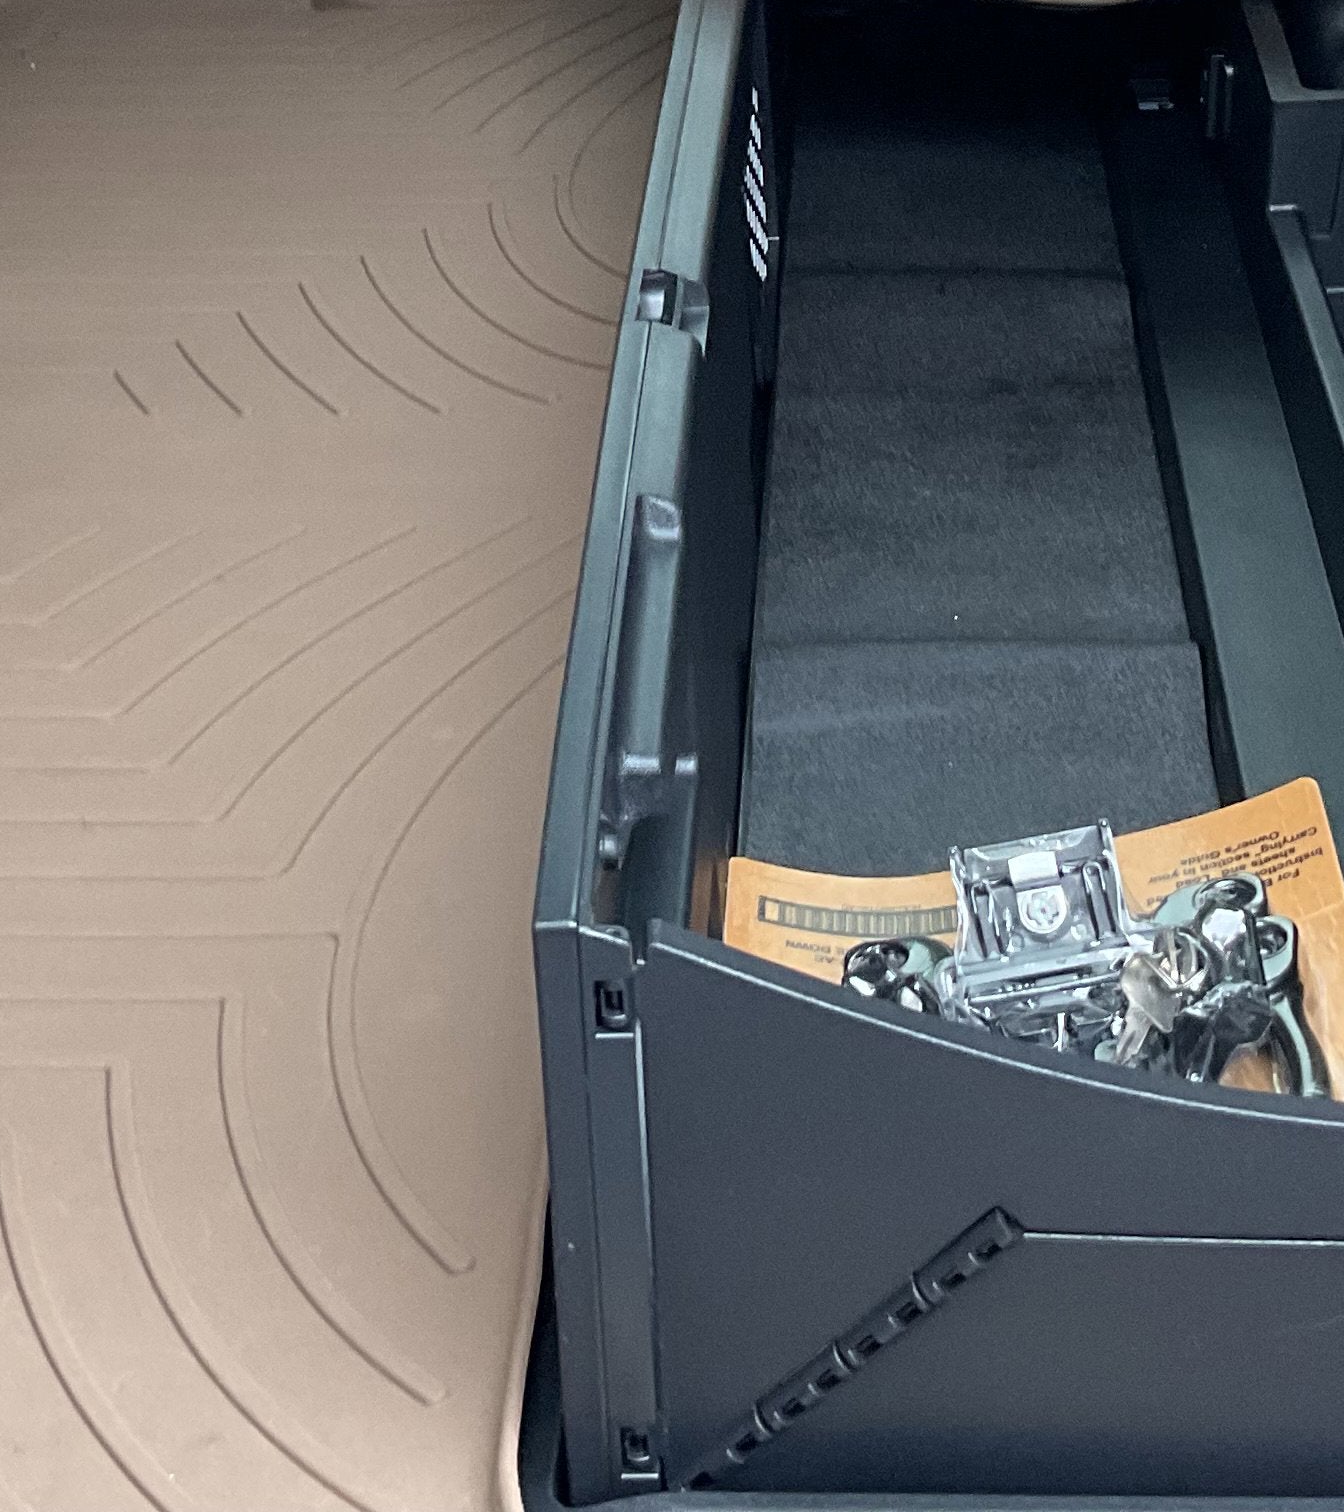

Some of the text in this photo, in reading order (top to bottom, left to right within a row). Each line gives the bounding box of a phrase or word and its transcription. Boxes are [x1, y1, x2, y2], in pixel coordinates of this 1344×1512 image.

[1180, 851, 1221, 866] Guide
[1200, 851, 1250, 870] section
[1251, 846, 1296, 867] sheets
[1147, 869, 1179, 884] your
[1221, 864, 1247, 876] and
[1277, 868, 1300, 881] For
